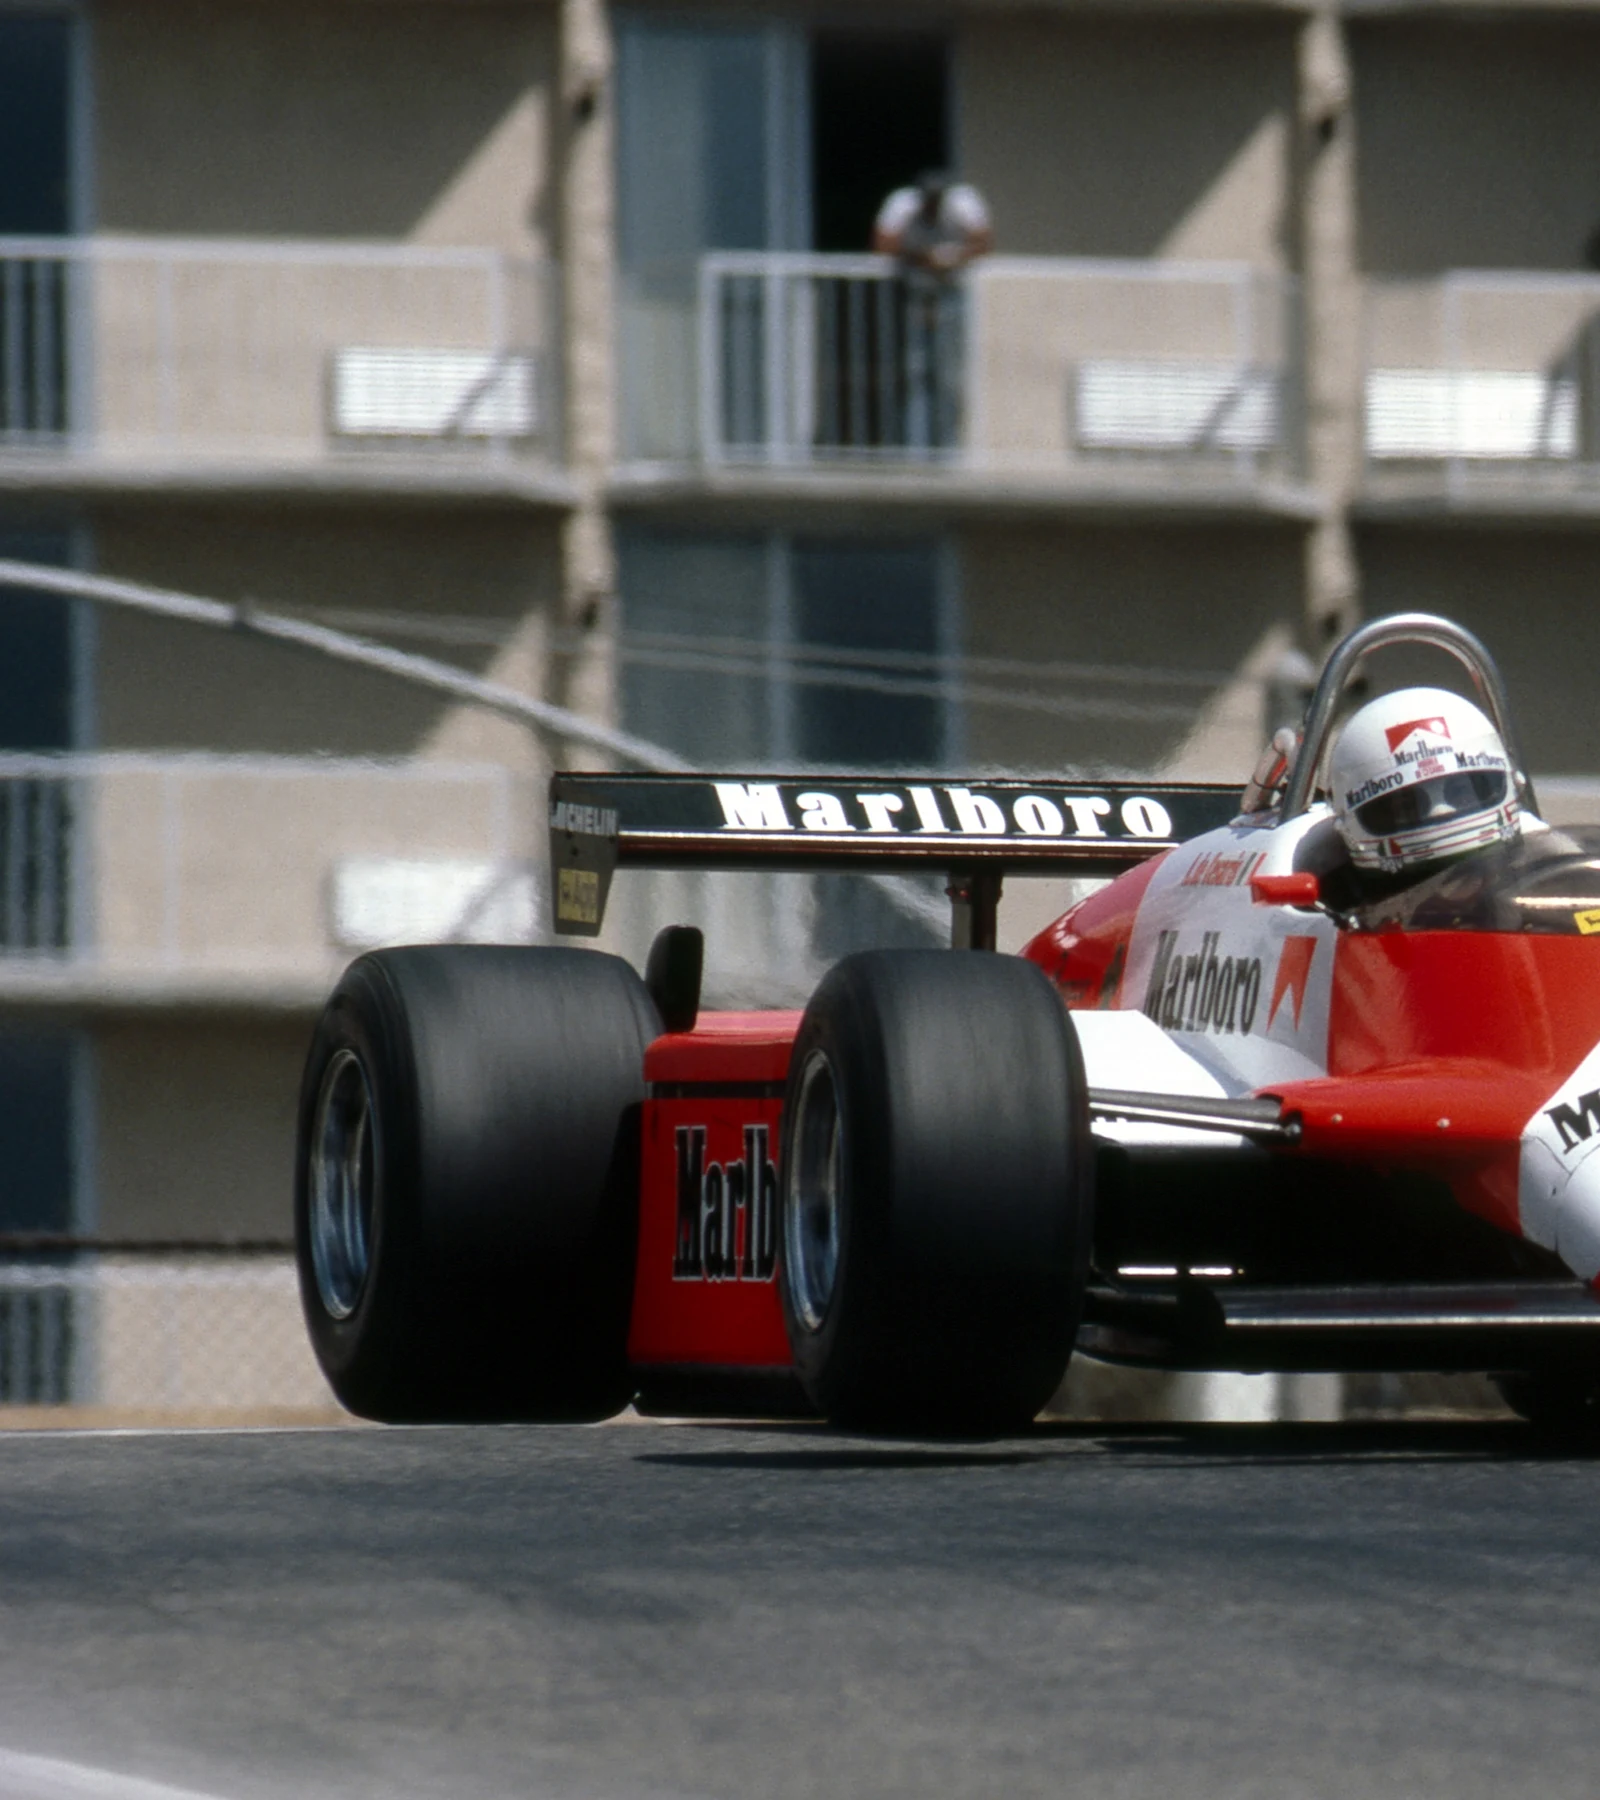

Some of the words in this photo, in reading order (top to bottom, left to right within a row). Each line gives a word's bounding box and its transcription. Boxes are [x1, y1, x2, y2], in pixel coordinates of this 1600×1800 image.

[713, 783, 1173, 839] Marlboro
[1143, 929, 1262, 1036] Marlboro
[672, 1124, 777, 1283] Marlb
